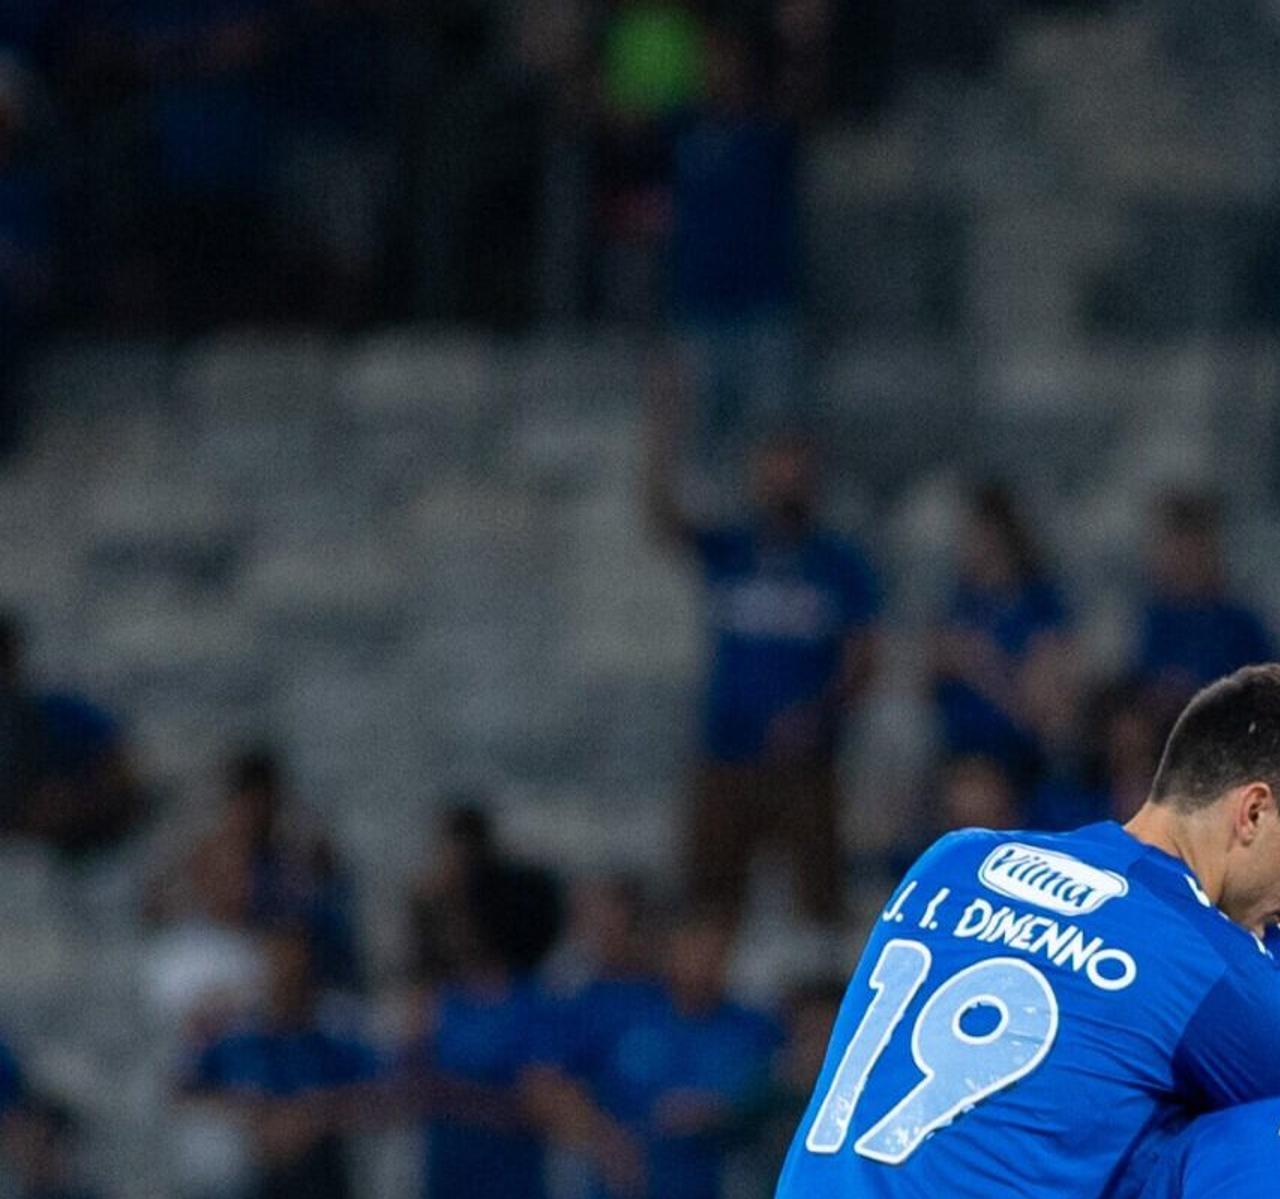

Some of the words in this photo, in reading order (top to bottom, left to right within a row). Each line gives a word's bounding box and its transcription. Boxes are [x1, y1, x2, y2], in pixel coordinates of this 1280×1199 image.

[990, 848, 1095, 908] Vilma
[883, 880, 918, 923] J.
[919, 887, 950, 930] I.
[953, 897, 1137, 991] DINENNO
[805, 938, 1060, 1165] 19
